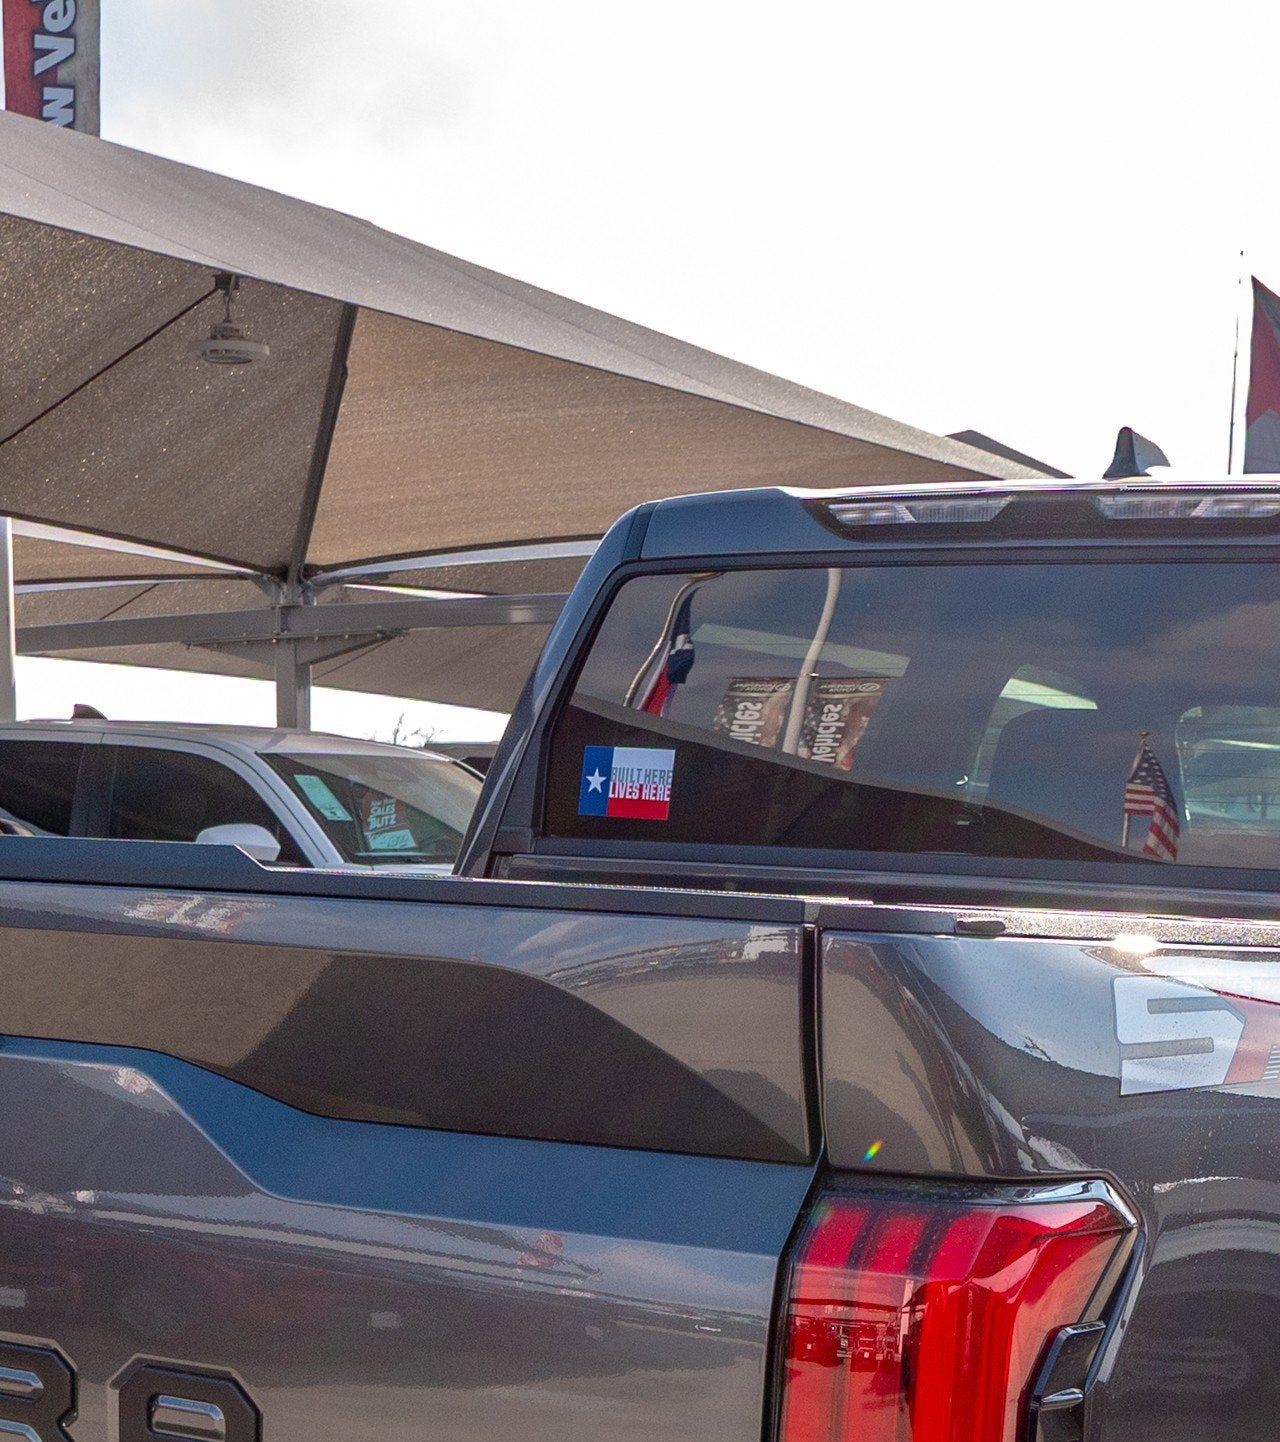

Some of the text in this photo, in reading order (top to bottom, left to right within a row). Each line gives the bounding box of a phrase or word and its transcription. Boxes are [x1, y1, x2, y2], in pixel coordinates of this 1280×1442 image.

[611, 767, 673, 785] BUILT HERE
[608, 781, 672, 802] LIVES HERE
